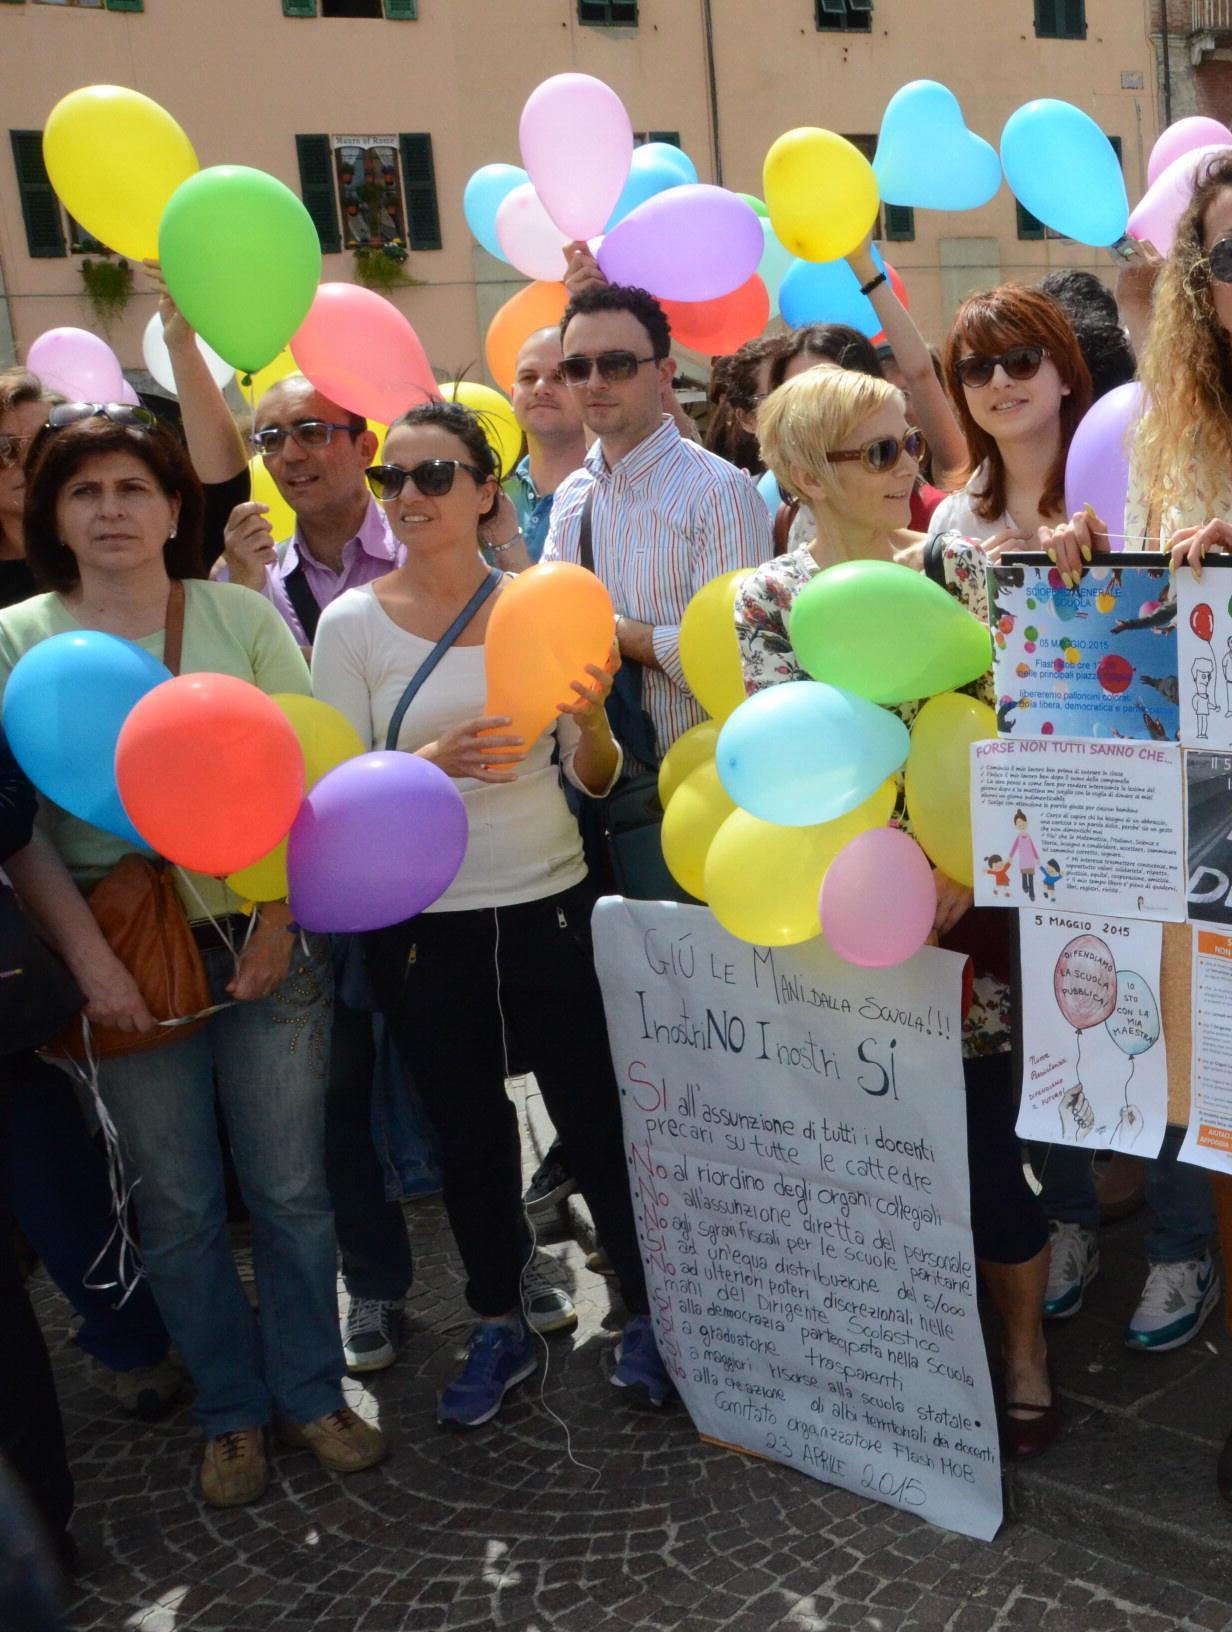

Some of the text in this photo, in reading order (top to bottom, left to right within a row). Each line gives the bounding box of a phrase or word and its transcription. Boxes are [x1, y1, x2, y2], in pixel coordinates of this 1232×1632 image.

[976, 741, 1174, 765] FORSE NON TUTTI SANNO CHE...
[1211, 756, 1218, 769] Il
[1224, 758, 1231, 770] 5
[1035, 916, 1130, 937] 5 MAGGIO 2015
[1064, 950, 1114, 973] DIFENDIAMO
[1214, 946, 1232, 956] NON
[711, 954, 737, 986] LE
[807, 987, 852, 1014] DALLA
[1060, 968, 1109, 990] LA SCUOLA
[1124, 994, 1138, 1004] STO
[1127, 982, 1136, 991] IO
[706, 1008, 746, 1054] NO
[1117, 1006, 1150, 1018] CON LA
[1127, 1018, 1143, 1028] MIA
[644, 1118, 932, 1194] precari su tutte le cattedre
[802, 1110, 818, 1139] di
[820, 1117, 858, 1147] tutti
[874, 1128, 936, 1163] docenti
[673, 1154, 689, 1182] al
[698, 1163, 765, 1192] riordino
[774, 1172, 812, 1215] degli
[818, 1188, 872, 1218] organi
[876, 1196, 942, 1231] collegiali
[739, 1220, 782, 1246] fiscali
[787, 1237, 813, 1261] per
[821, 1236, 838, 1259] le
[844, 1248, 899, 1271] scuole
[802, 1214, 865, 1246] diretta
[872, 1229, 896, 1252] del
[904, 1244, 972, 1279] personale
[664, 1276, 940, 1354] mani Dirigente Scolastico
[680, 1258, 698, 1276] ad
[768, 1278, 809, 1300] poteri
[823, 1292, 914, 1326] discrezionali
[920, 1314, 956, 1342] nelle
[679, 1298, 702, 1316] alla
[706, 1302, 785, 1332] democrazia
[888, 1349, 919, 1369] nella
[682, 1320, 692, 1335] a
[804, 1348, 903, 1392] trasparenti
[693, 1367, 719, 1387] alla
[810, 1396, 825, 1414] di
[828, 1381, 852, 1398] alla
[860, 1392, 905, 1414] scuola
[892, 1441, 935, 1470] Flash
[860, 1463, 927, 1508] 2015
